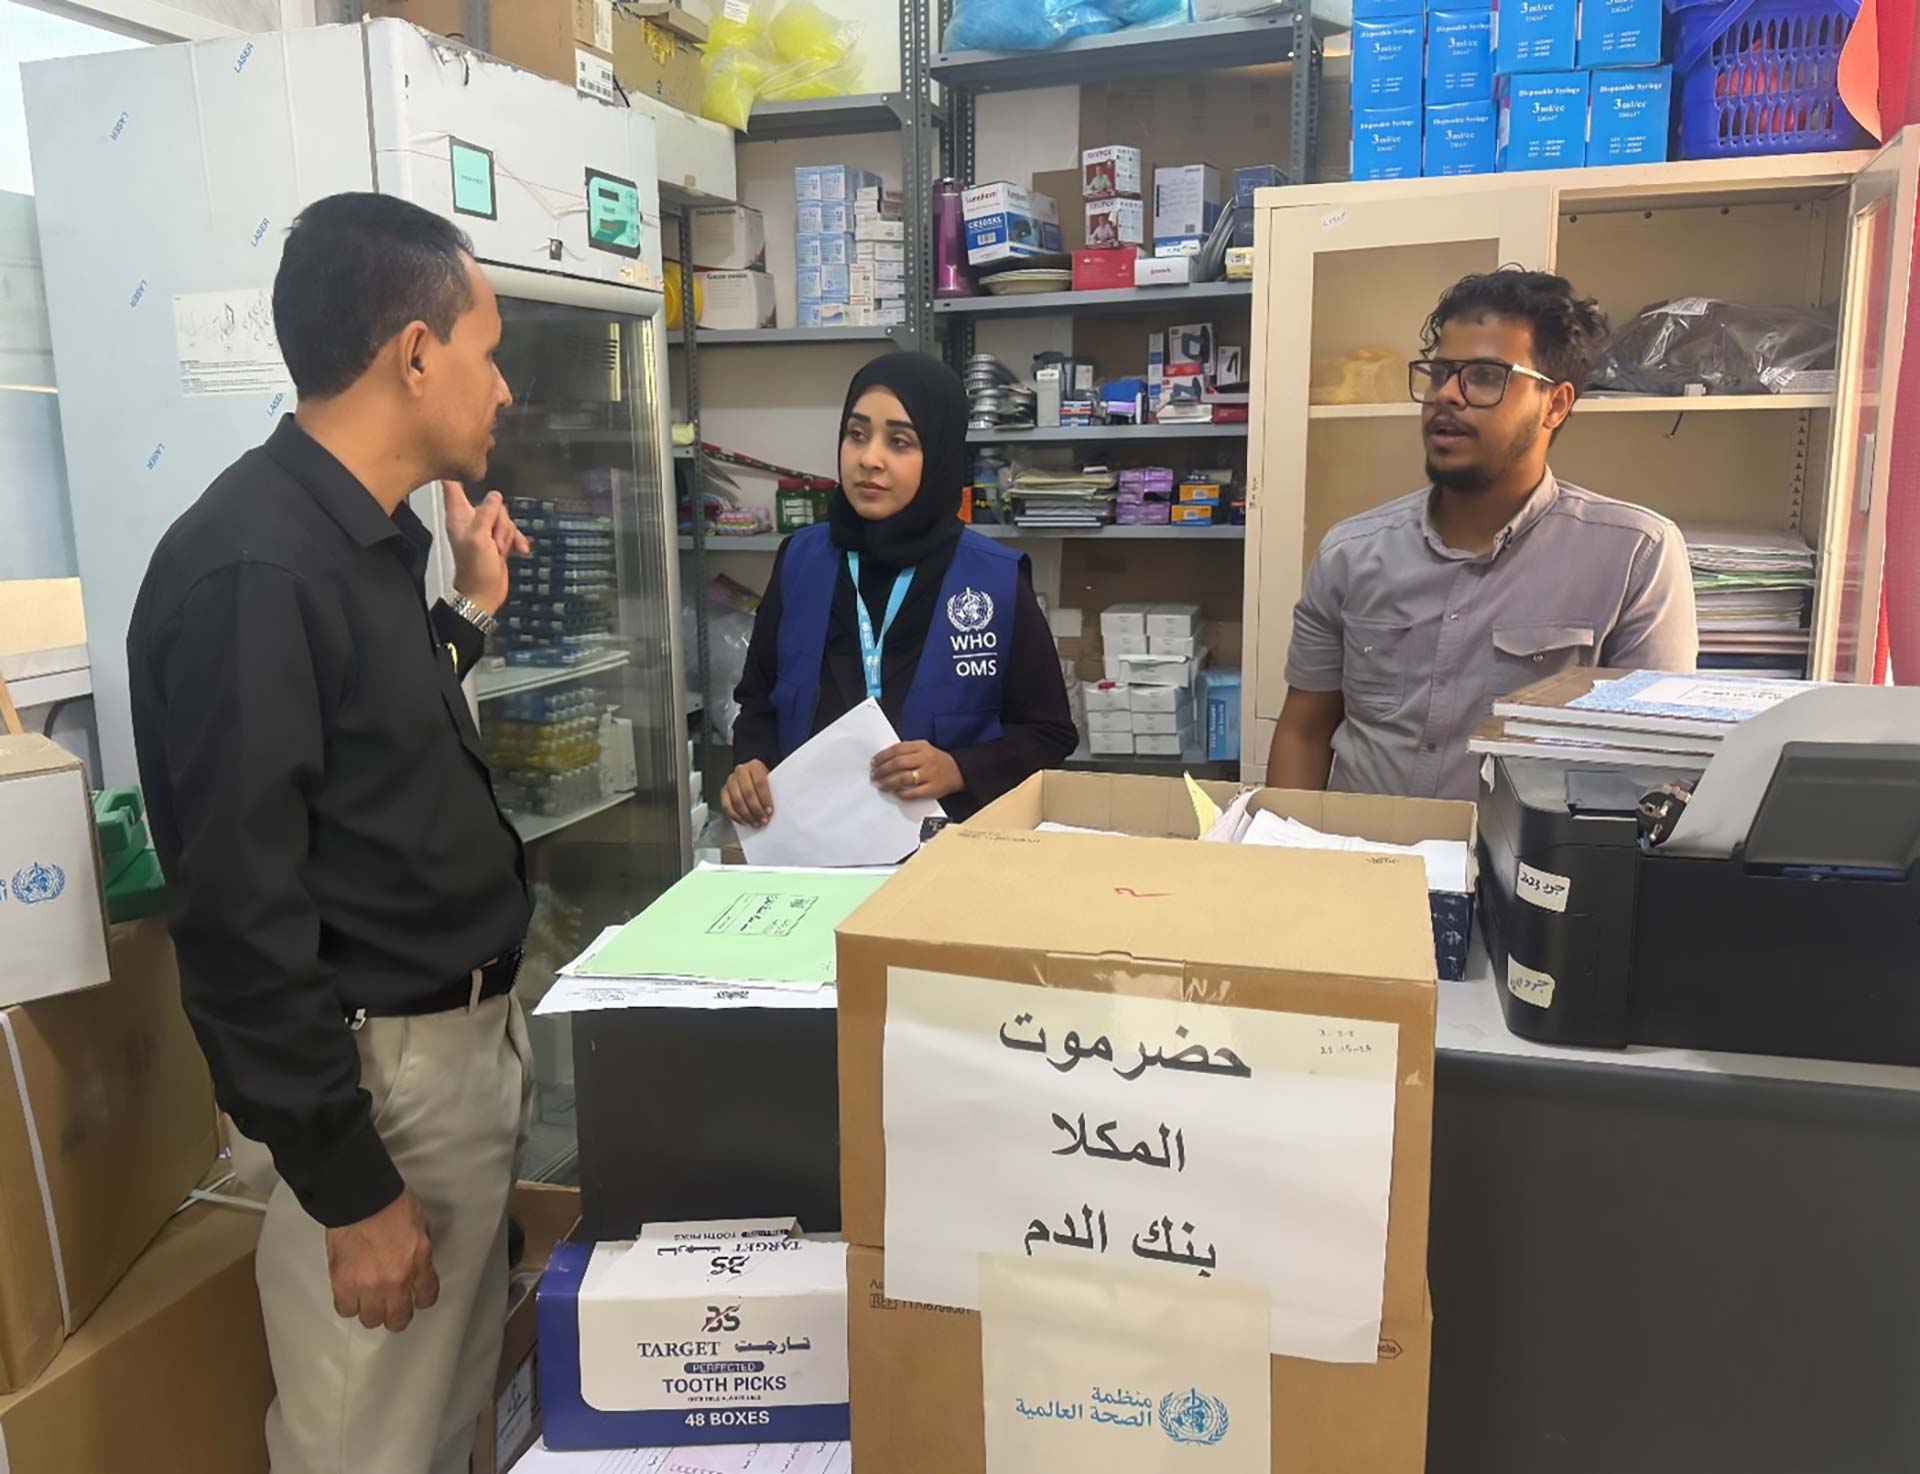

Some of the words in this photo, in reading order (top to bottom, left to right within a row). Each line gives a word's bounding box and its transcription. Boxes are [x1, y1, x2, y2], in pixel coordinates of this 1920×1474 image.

[233, 42, 254, 73] LASER
[110, 111, 128, 141] LASER
[251, 217, 269, 247] LASER
[130, 279, 148, 308] LASER
[267, 393, 283, 416] LASE
[147, 442, 165, 470] LASER
[950, 631, 997, 651] WHO
[956, 659, 997, 677] OMS
[1000, 1013, 1251, 1080] حضرموت
[1052, 1113, 1185, 1172] المكلا
[1025, 1204, 1108, 1256] الدم
[733, 1241, 803, 1253] TARGET
[1133, 1215, 1216, 1278] بنك
[637, 1341, 721, 1358] TARGET
[692, 1363, 756, 1374] PERFECTED
[662, 1377, 728, 1394] TOOTH
[734, 1375, 787, 1392] PICKS
[1015, 1398, 1083, 1420] العالمية
[1091, 1387, 1151, 1408] منظمة
[685, 1412, 706, 1427] 48
[710, 1410, 770, 1426] BOXES
[1090, 1405, 1151, 1428] الصحة
